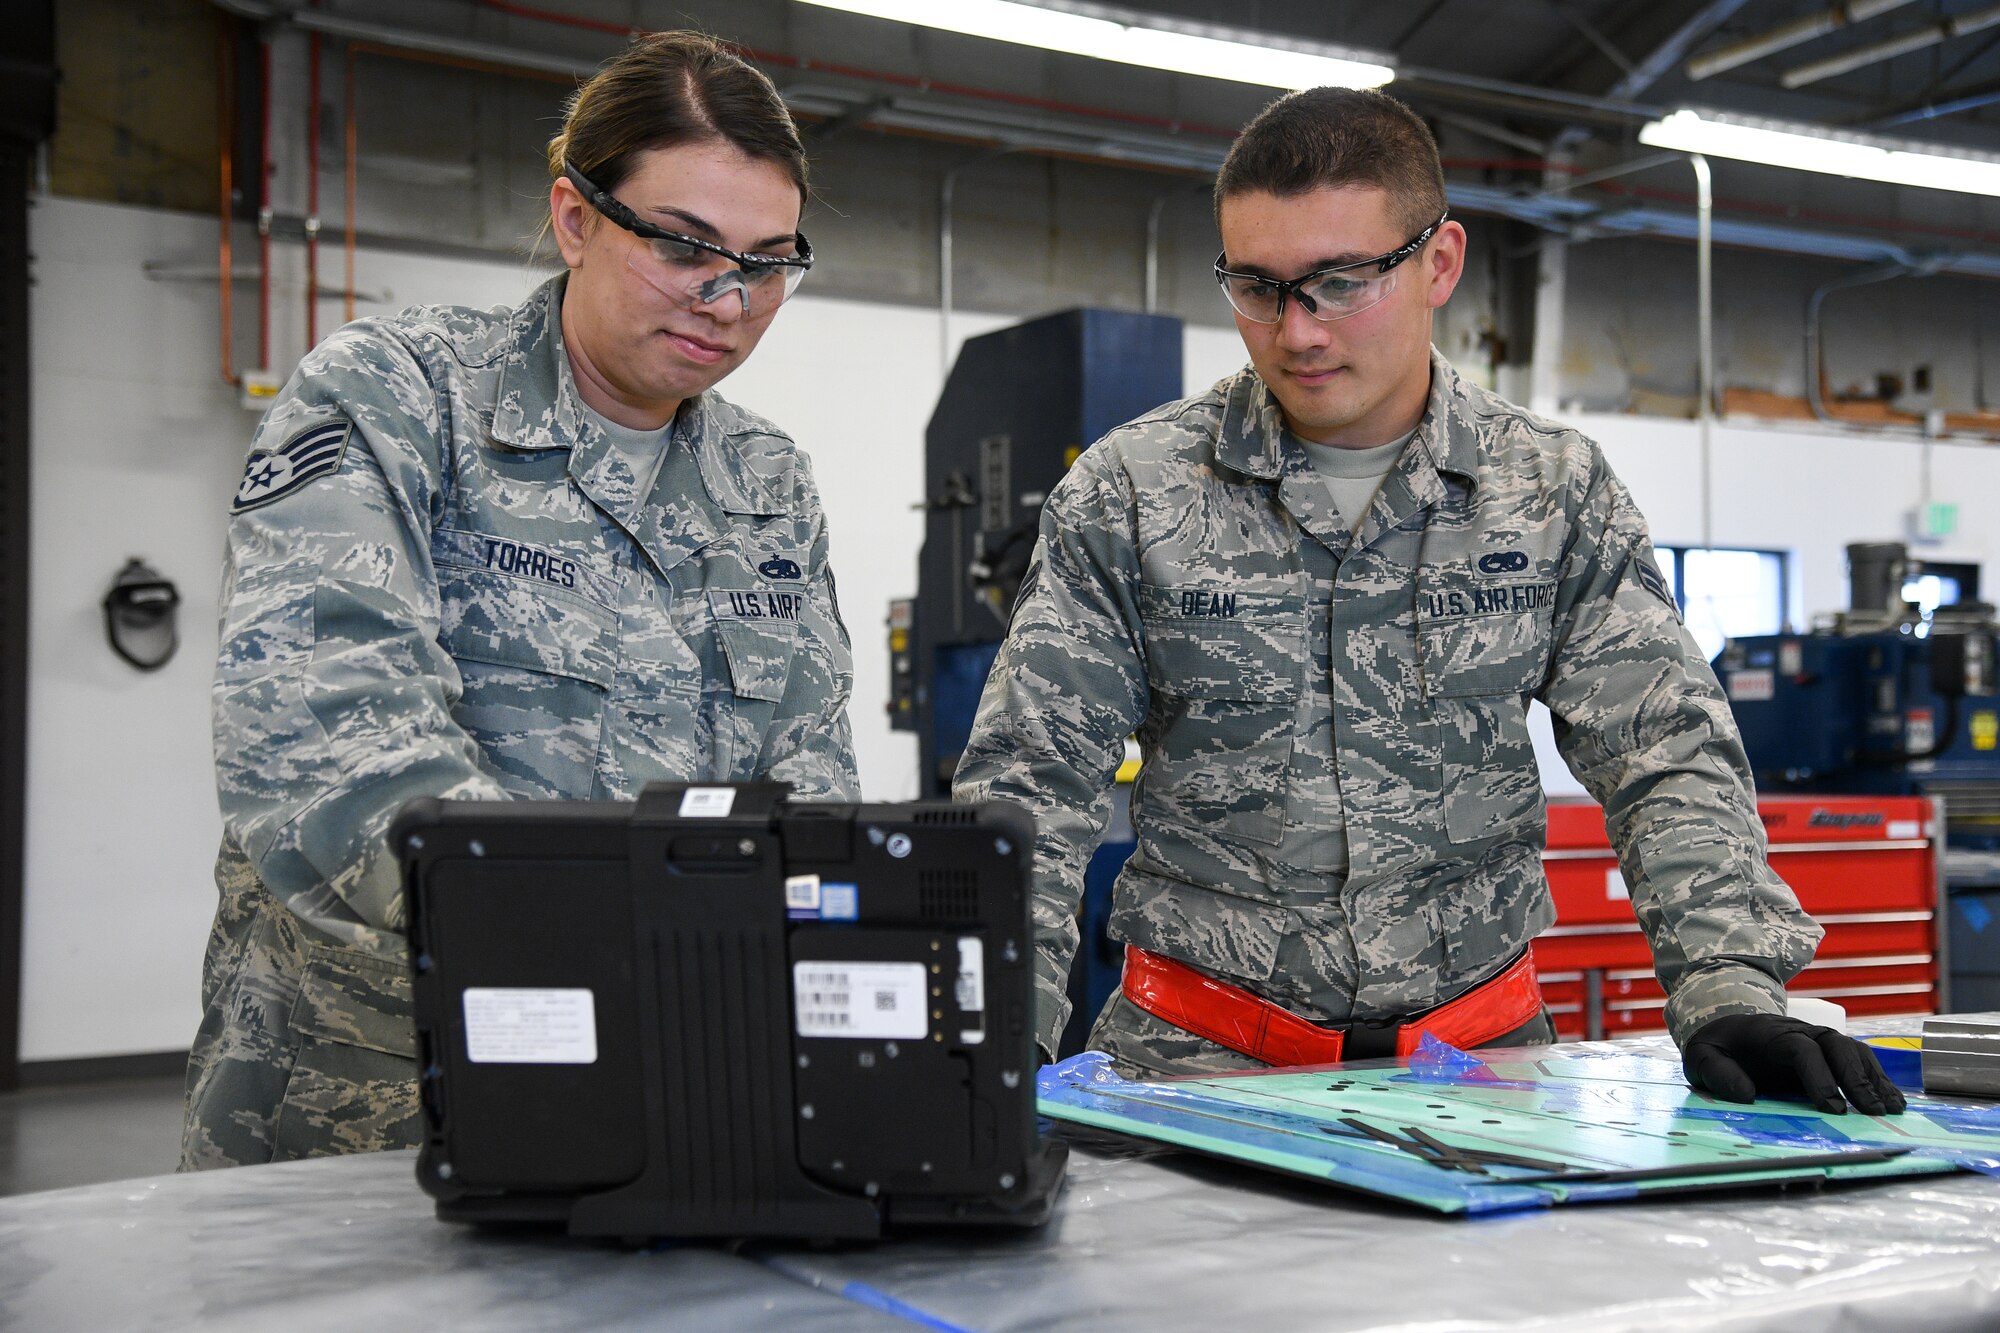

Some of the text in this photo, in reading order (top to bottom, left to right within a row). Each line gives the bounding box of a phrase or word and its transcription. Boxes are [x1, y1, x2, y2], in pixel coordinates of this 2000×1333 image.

[485, 539, 576, 588] TORRES
[729, 592, 767, 617] U.S.
[1182, 591, 1236, 617] DEAN
[1428, 581, 1557, 618] U.S. AIR FORCE
